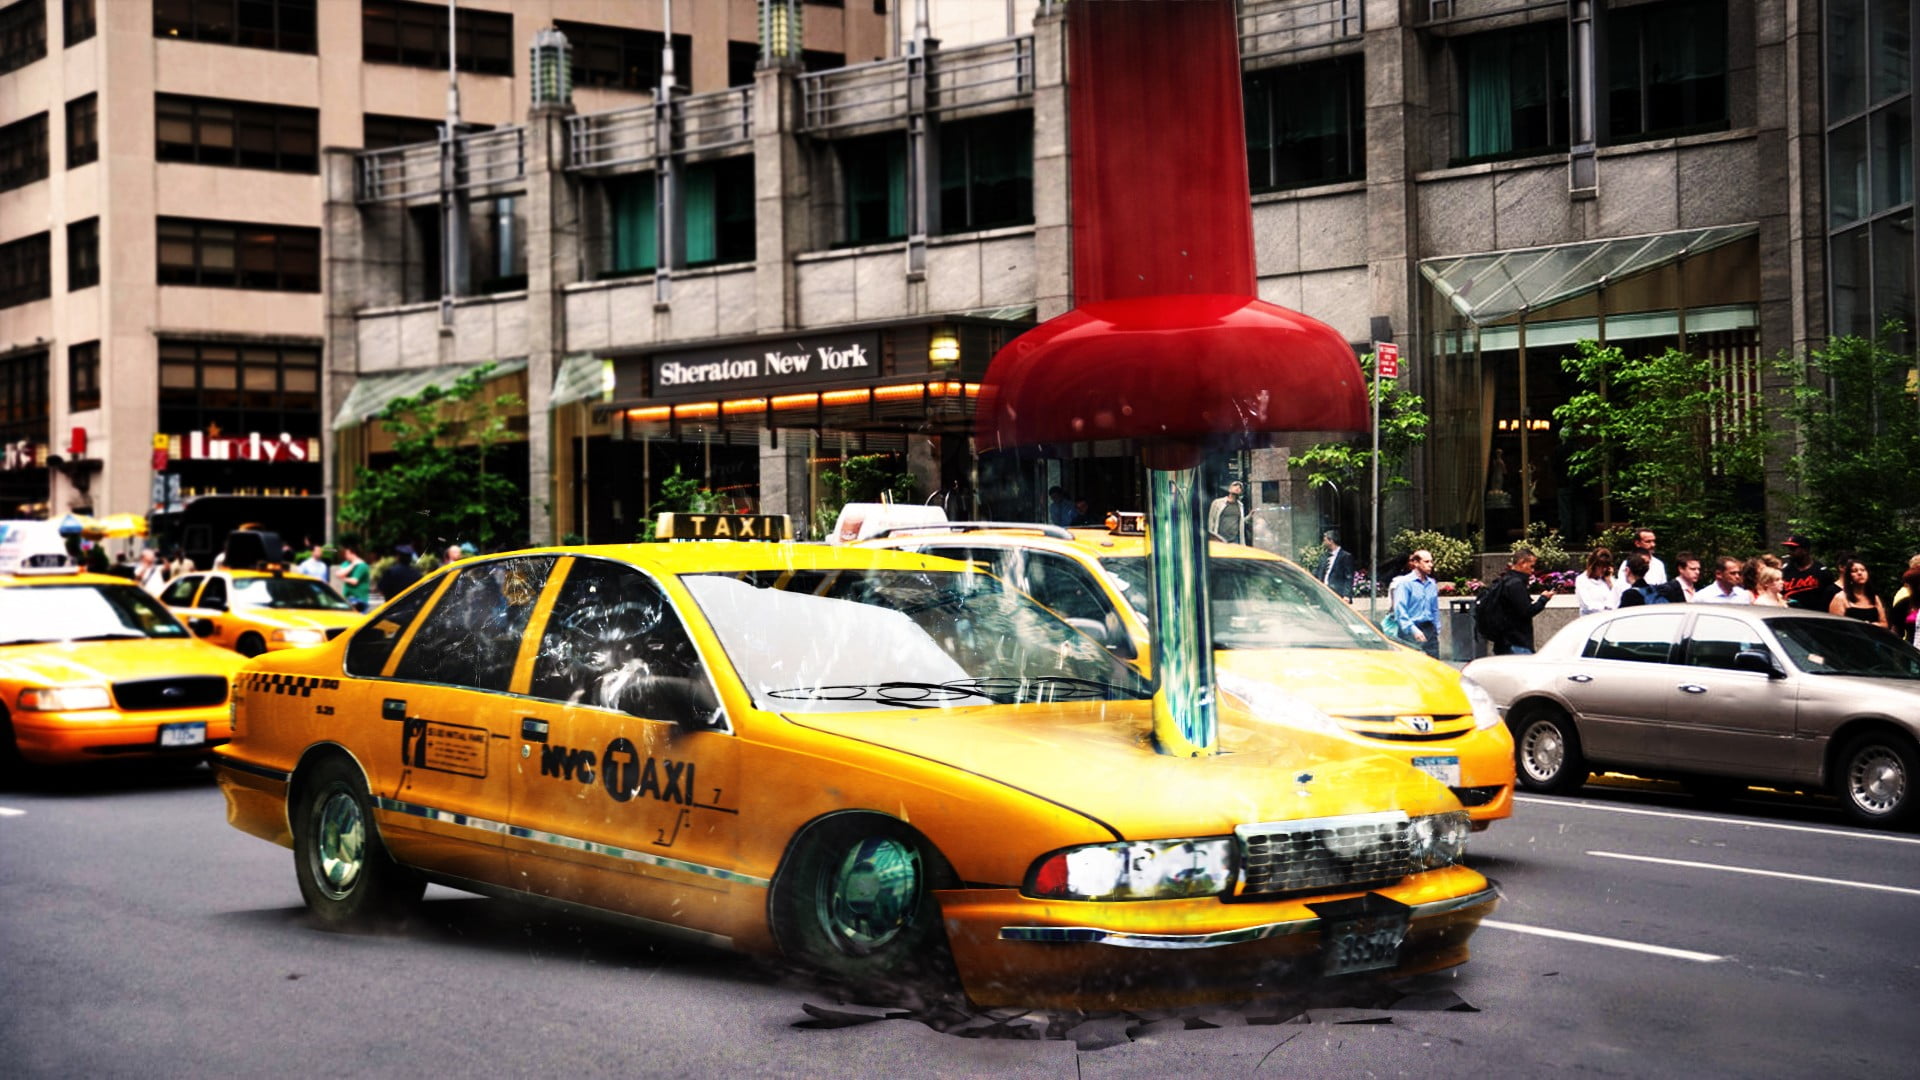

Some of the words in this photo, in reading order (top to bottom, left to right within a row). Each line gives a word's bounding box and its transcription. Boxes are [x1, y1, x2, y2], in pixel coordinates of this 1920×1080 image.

[660, 362, 758, 386] Sheraton
[764, 352, 811, 376] New
[817, 344, 869, 371] York
[190, 431, 305, 464] Lindy's
[690, 516, 769, 537] TAXI
[541, 744, 597, 784] NYC
[604, 741, 695, 807] TAXI
